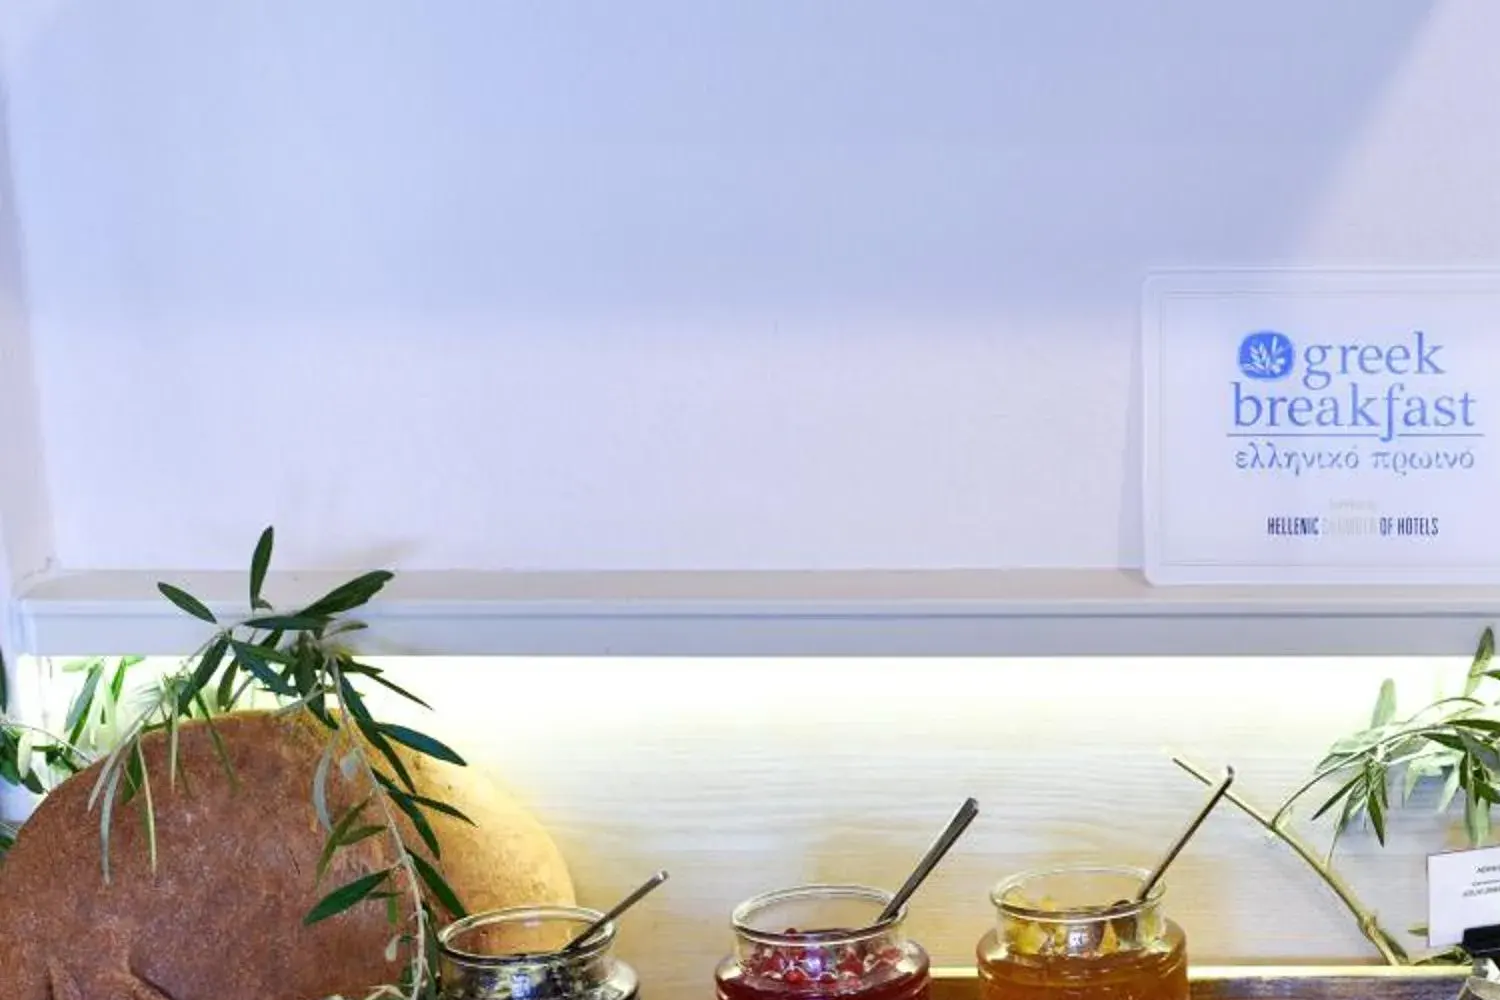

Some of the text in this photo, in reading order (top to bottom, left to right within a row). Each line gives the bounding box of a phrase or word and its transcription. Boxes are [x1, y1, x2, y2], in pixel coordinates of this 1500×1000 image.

[1303, 332, 1446, 391] greek
[1231, 382, 1477, 442] breakfast
[1234, 442, 1476, 477] ελληνικό πρωινό
[1267, 516, 1319, 536] HELLENIC
[1379, 516, 1393, 536] OF
[1397, 516, 1440, 537] HOTELS
